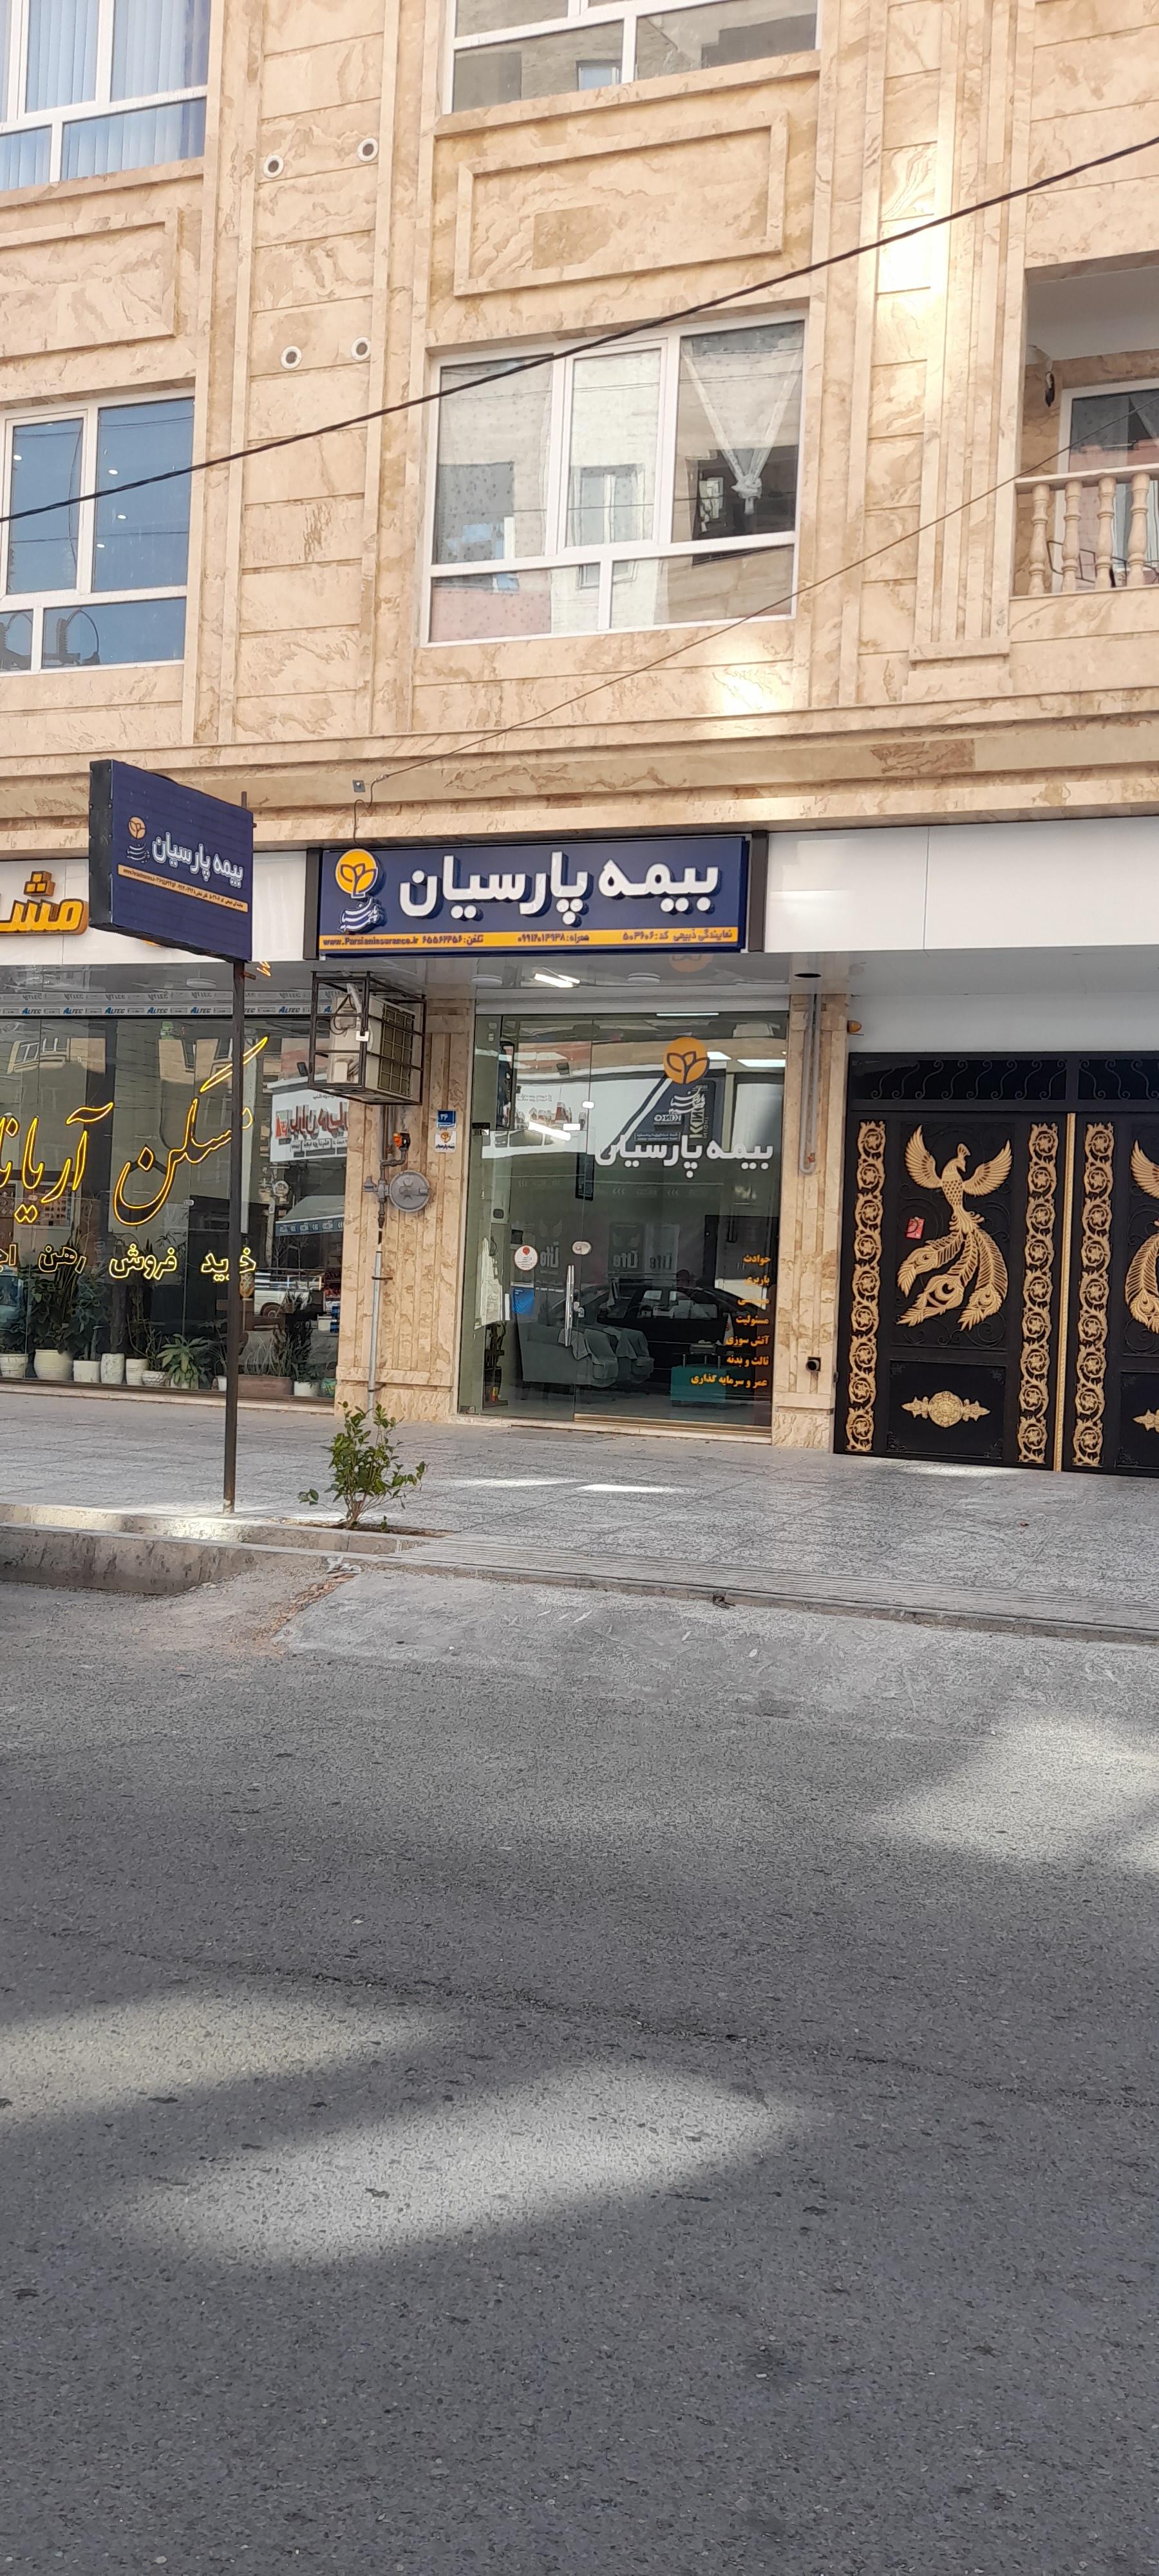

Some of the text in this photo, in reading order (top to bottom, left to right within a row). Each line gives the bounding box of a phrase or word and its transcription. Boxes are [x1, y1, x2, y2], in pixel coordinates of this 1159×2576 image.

[152, 831, 211, 882] پارسیان
[212, 854, 243, 888] بیمه
[399, 851, 719, 925] بیمه پارسیان
[0, 871, 86, 934] مش
[595, 1134, 773, 1179] بیمه پارسیان
[39, 1245, 87, 1273] رهن
[109, 1244, 177, 1280] فروش
[200, 1247, 256, 1282] خید
[743, 1254, 771, 1265] حوادث
[744, 1274, 770, 1285] باربری
[735, 1314, 769, 1326] مسئولیت
[726, 1335, 770, 1347] آتش سوزی
[726, 1355, 743, 1367] بدنه
[718, 1375, 744, 1387] سرمایه
[753, 1379, 768, 1388] عمر
